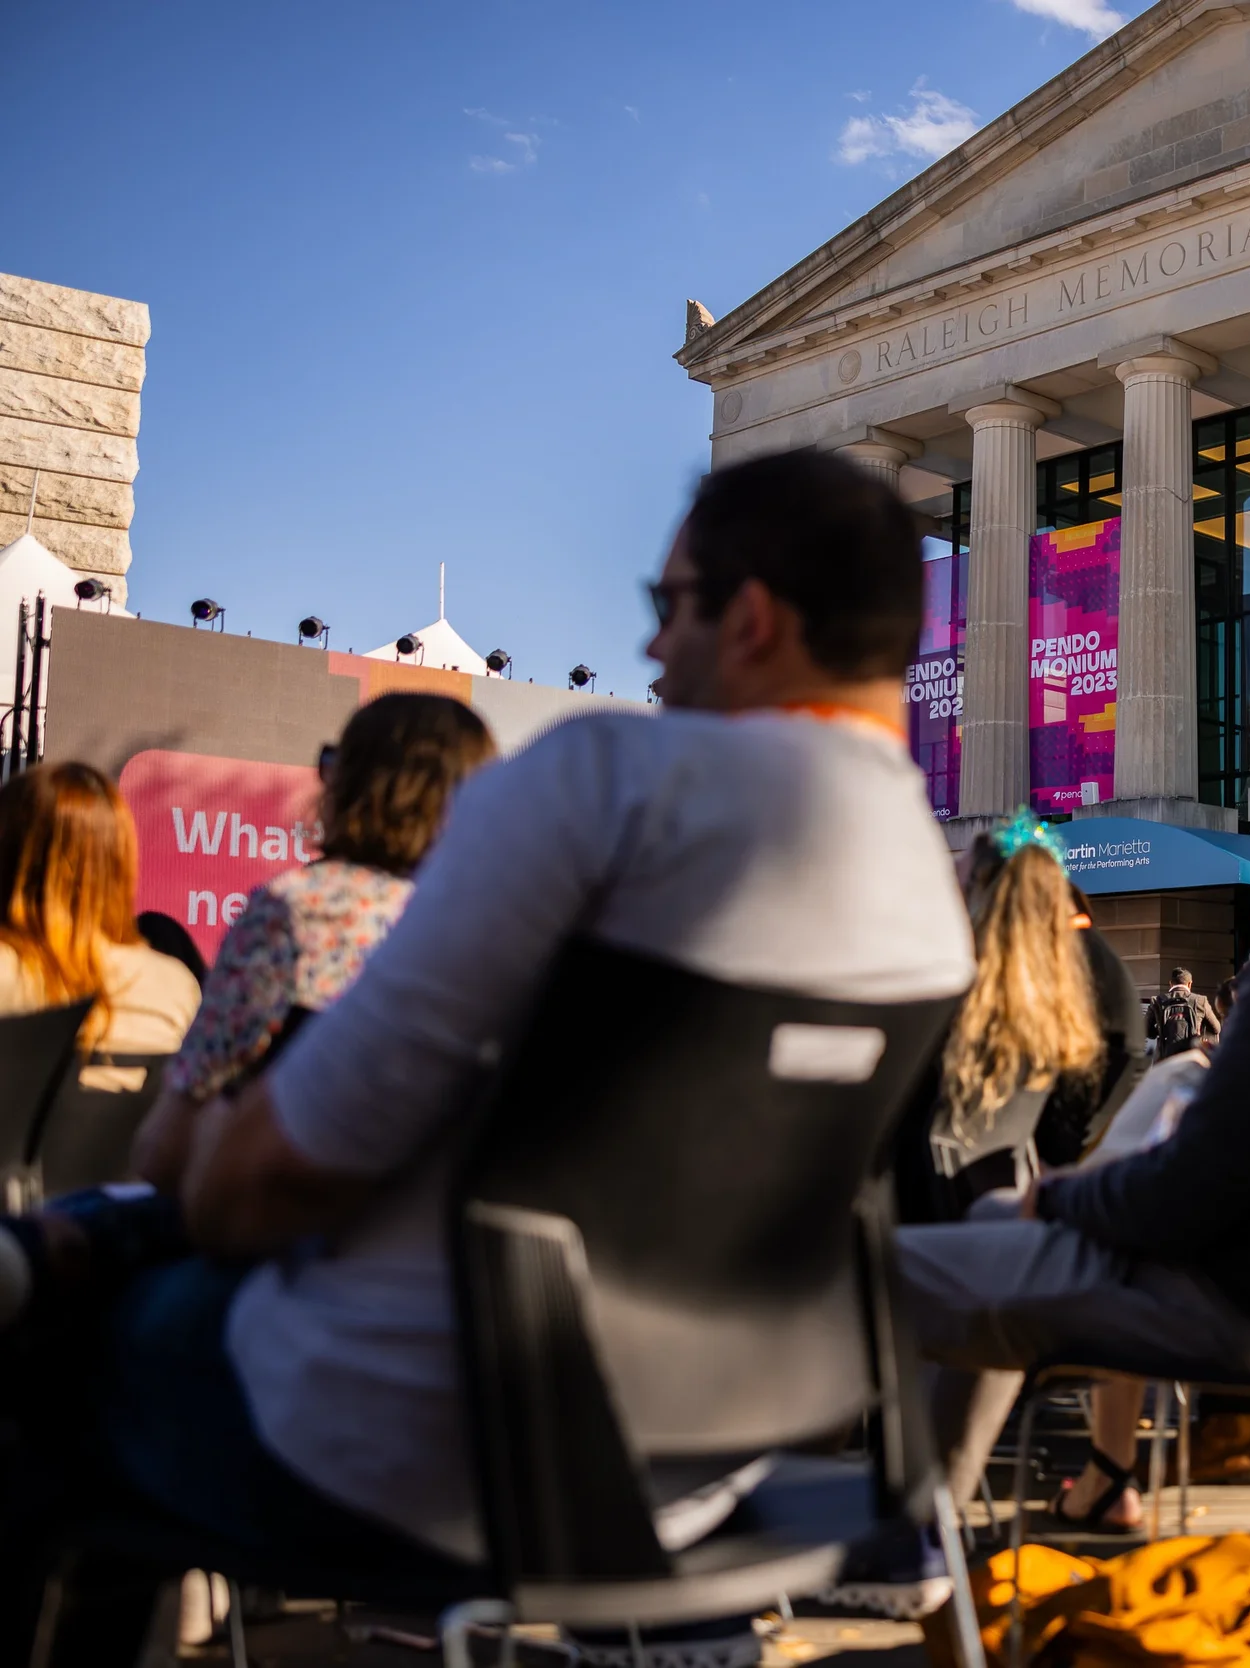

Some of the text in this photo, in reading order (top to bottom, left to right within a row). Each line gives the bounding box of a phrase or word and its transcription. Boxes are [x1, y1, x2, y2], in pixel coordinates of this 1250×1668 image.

[876, 292, 1028, 372] RALEIGH
[1031, 630, 1100, 658] PENDO
[905, 657, 956, 683] ENDO
[1030, 648, 1117, 679] MONIUM
[1070, 670, 1118, 696] 2023
[929, 696, 964, 720] 202
[1063, 839, 1151, 860] artin Marietta
[1078, 861, 1088, 873] for
[1097, 858, 1134, 869] Performing
[1135, 857, 1150, 866] Arts
